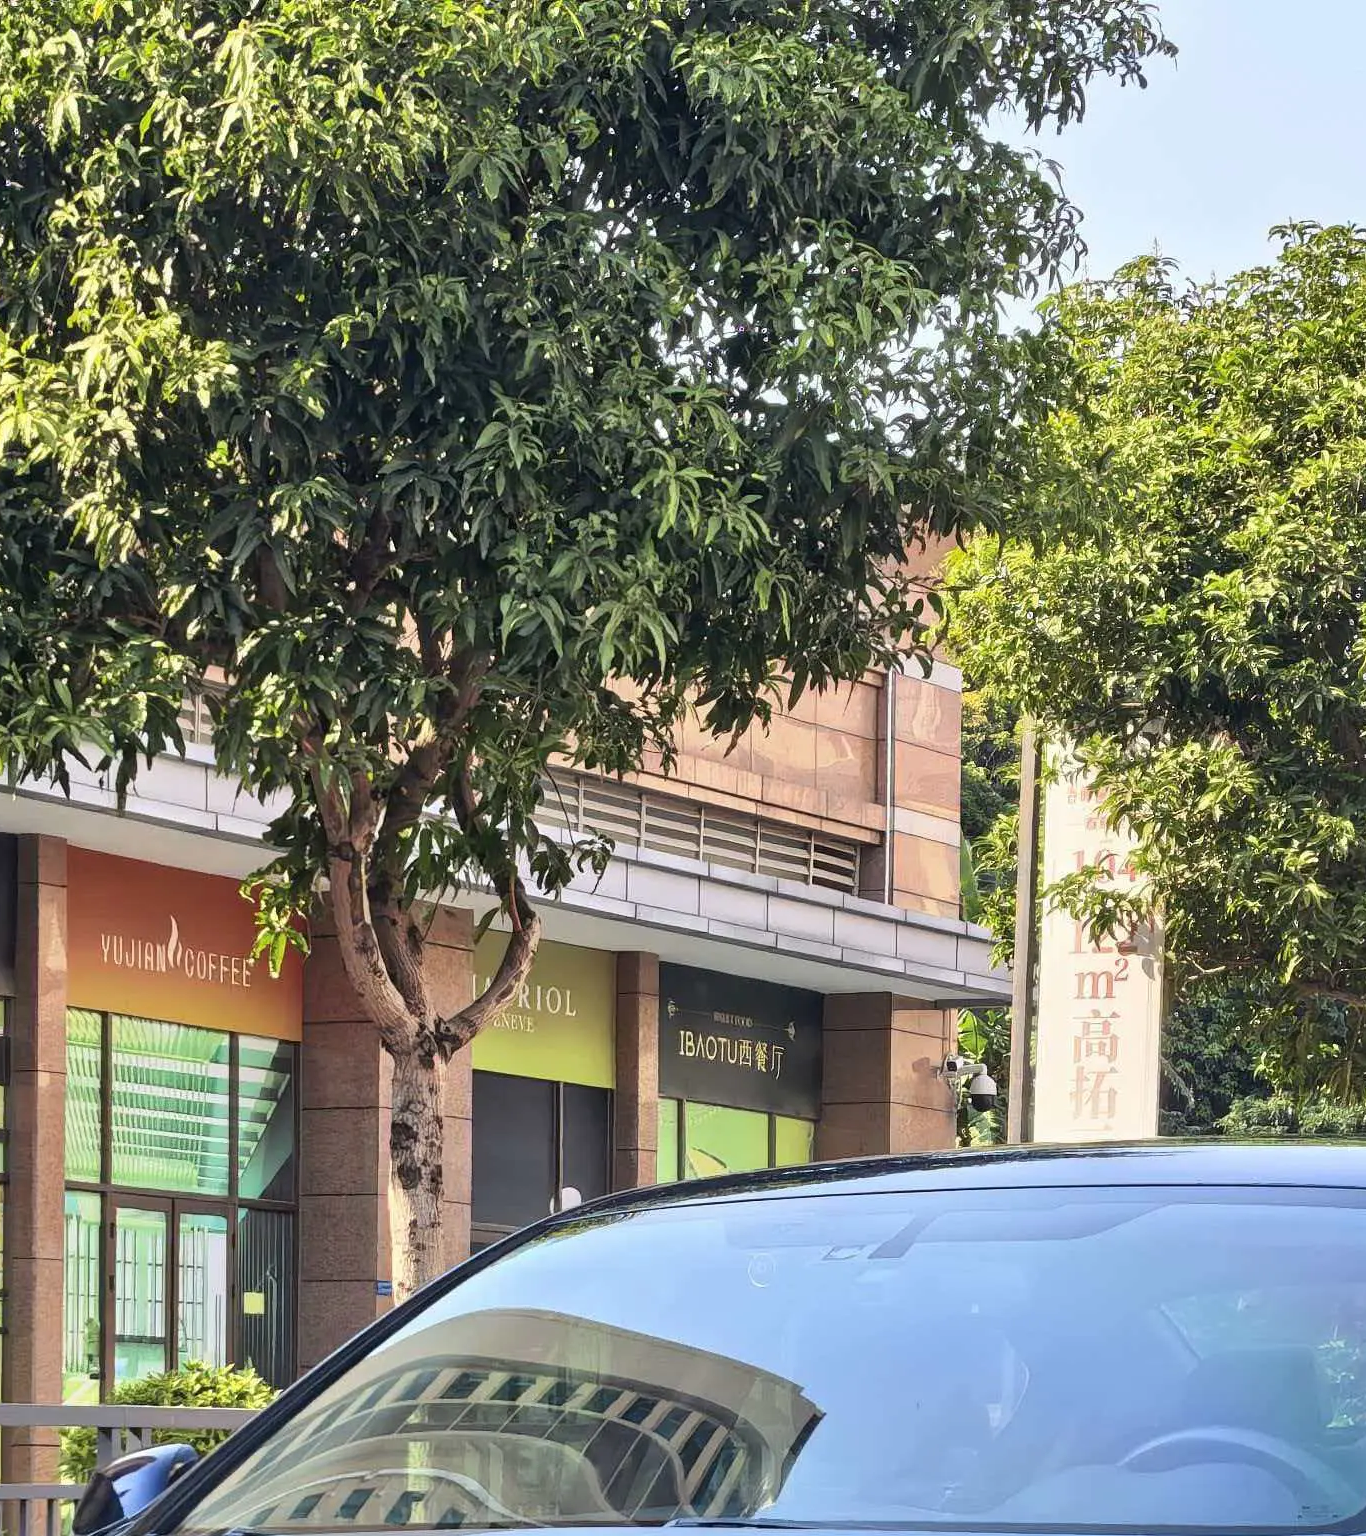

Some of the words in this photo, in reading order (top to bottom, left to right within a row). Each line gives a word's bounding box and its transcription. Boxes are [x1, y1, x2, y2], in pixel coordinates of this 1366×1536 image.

[101, 933, 166, 973] YUJIAN
[185, 948, 251, 987] COFFEE
[1069, 1008, 1122, 1133] 高拓
